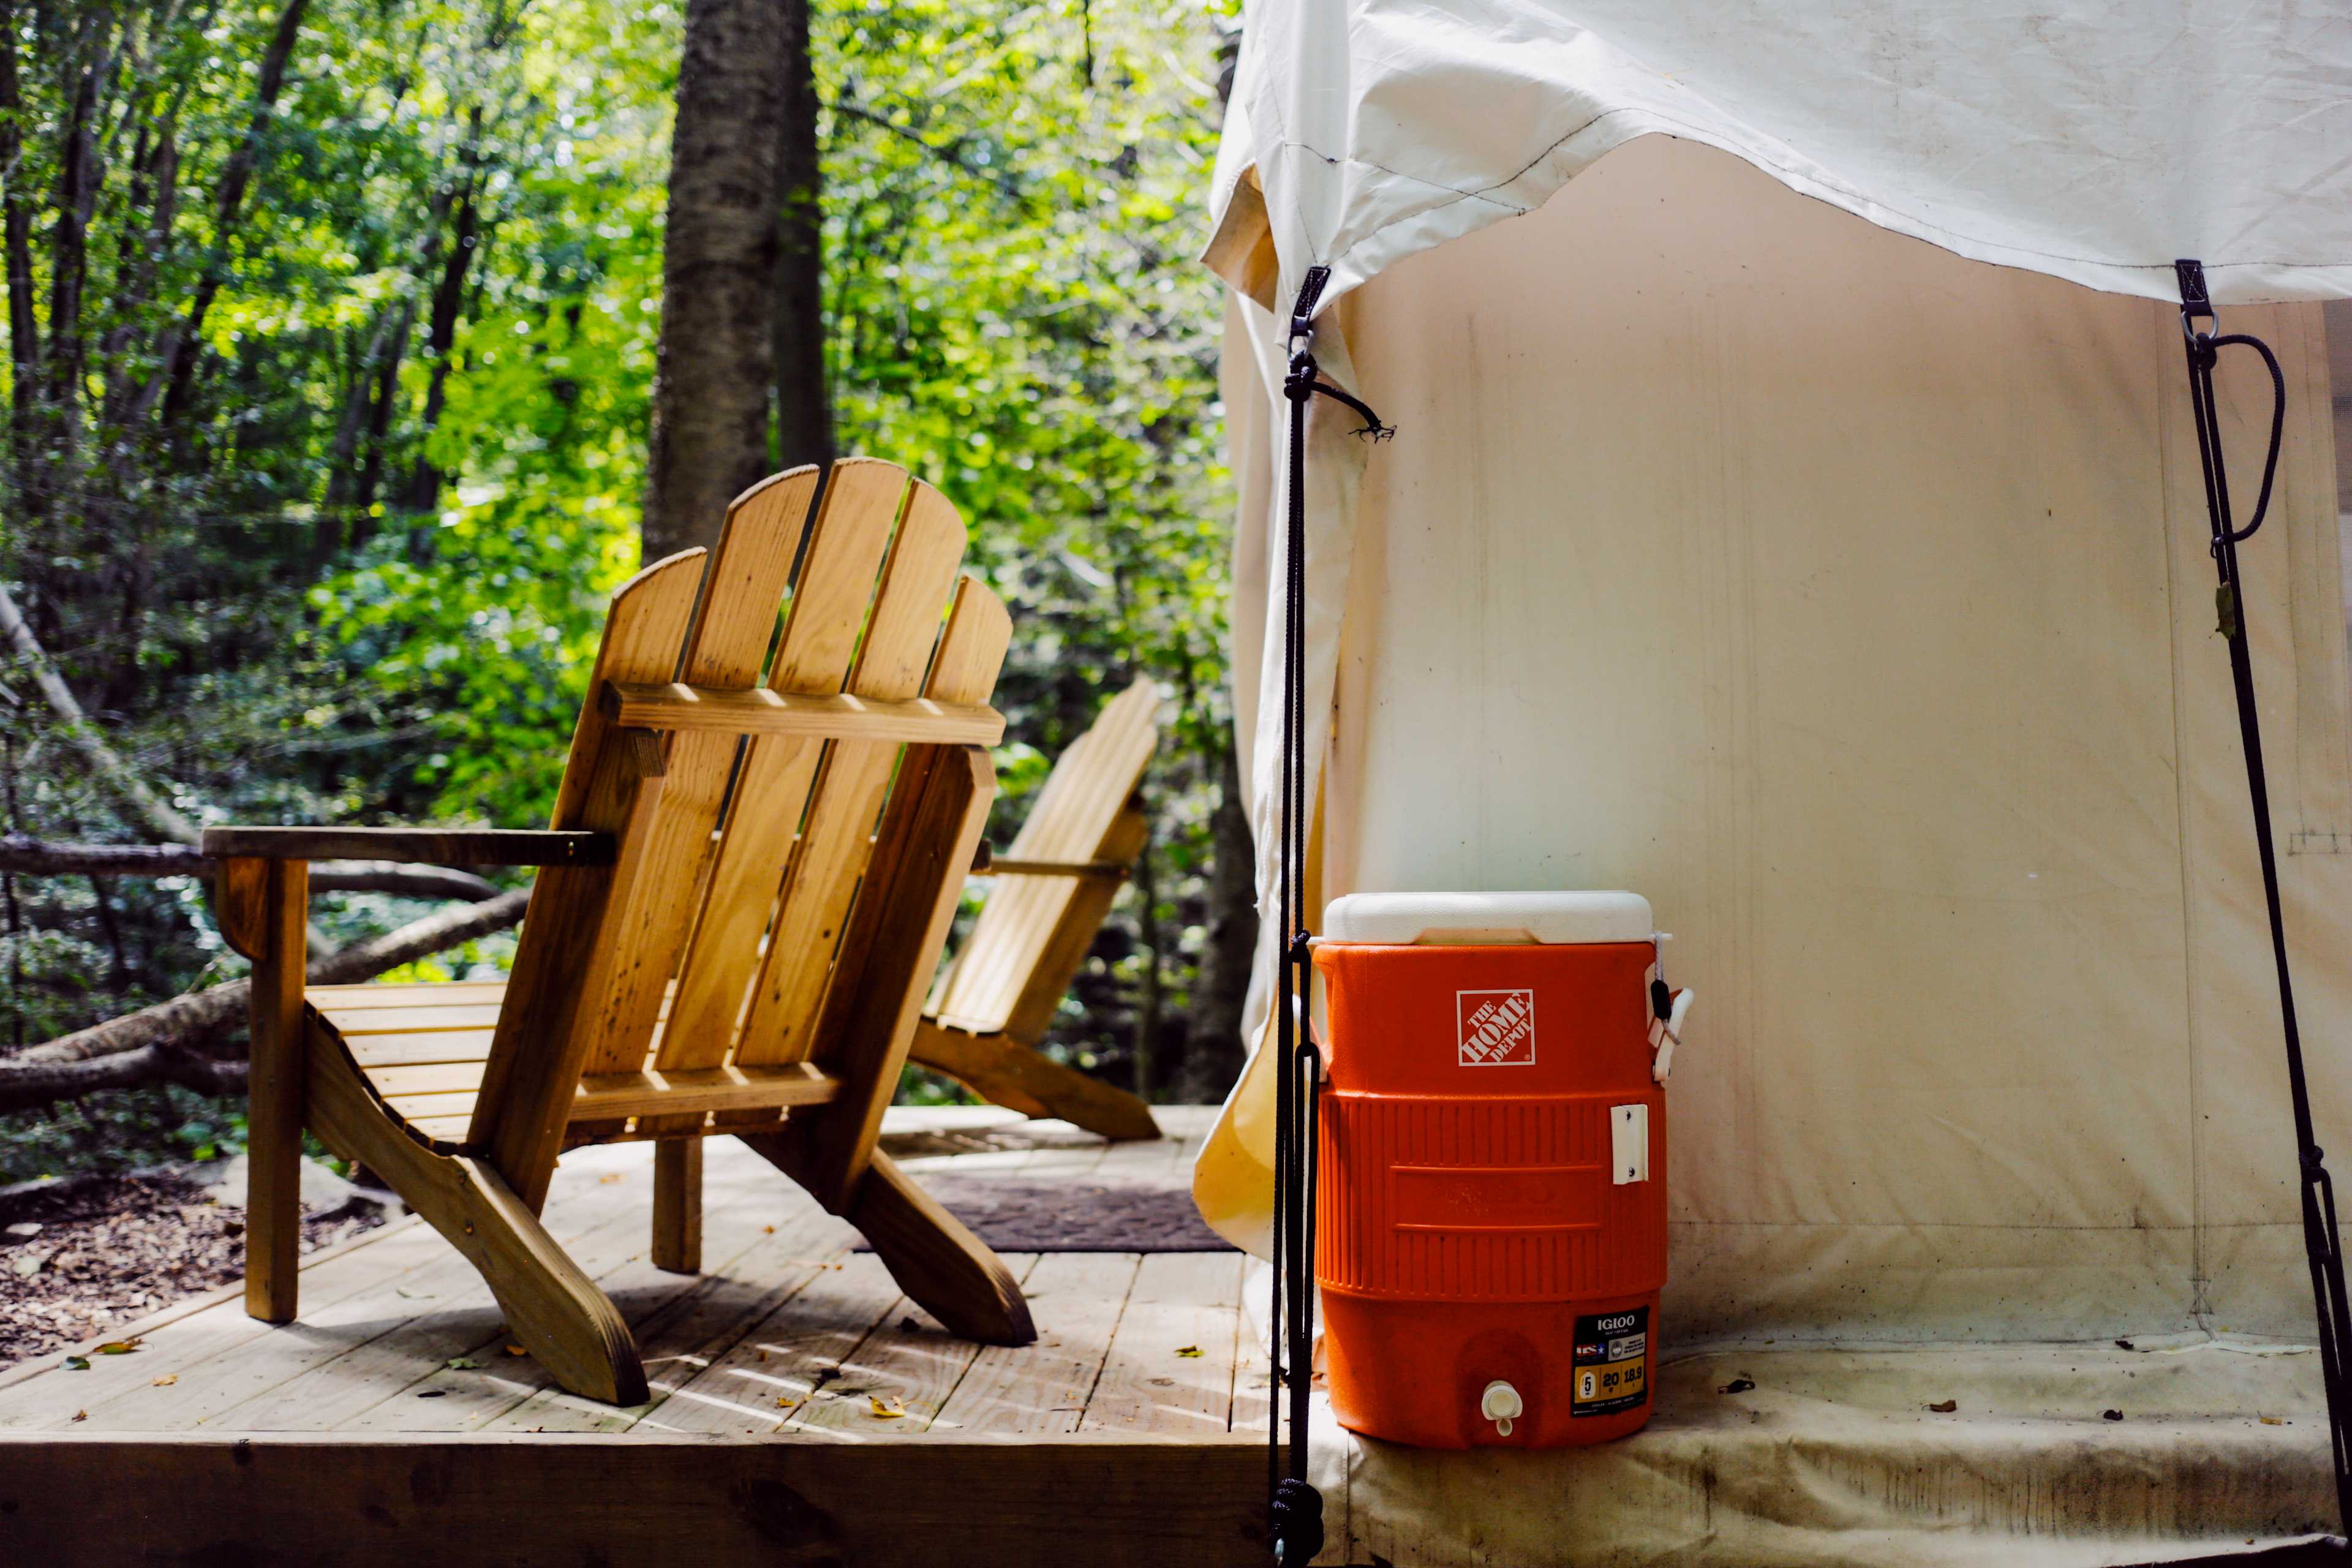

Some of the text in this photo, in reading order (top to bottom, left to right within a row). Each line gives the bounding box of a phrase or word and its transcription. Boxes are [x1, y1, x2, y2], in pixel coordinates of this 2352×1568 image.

[1467, 1000, 1497, 1029] THE
[1461, 992, 1530, 1063] HOME
[1489, 1018, 1531, 1063] DEPOT
[1597, 1315, 1635, 1330] IGLOO
[1602, 1371, 1619, 1387] 20
[1624, 1366, 1643, 1383] 18.9
[1585, 1376, 1591, 1392] 5
